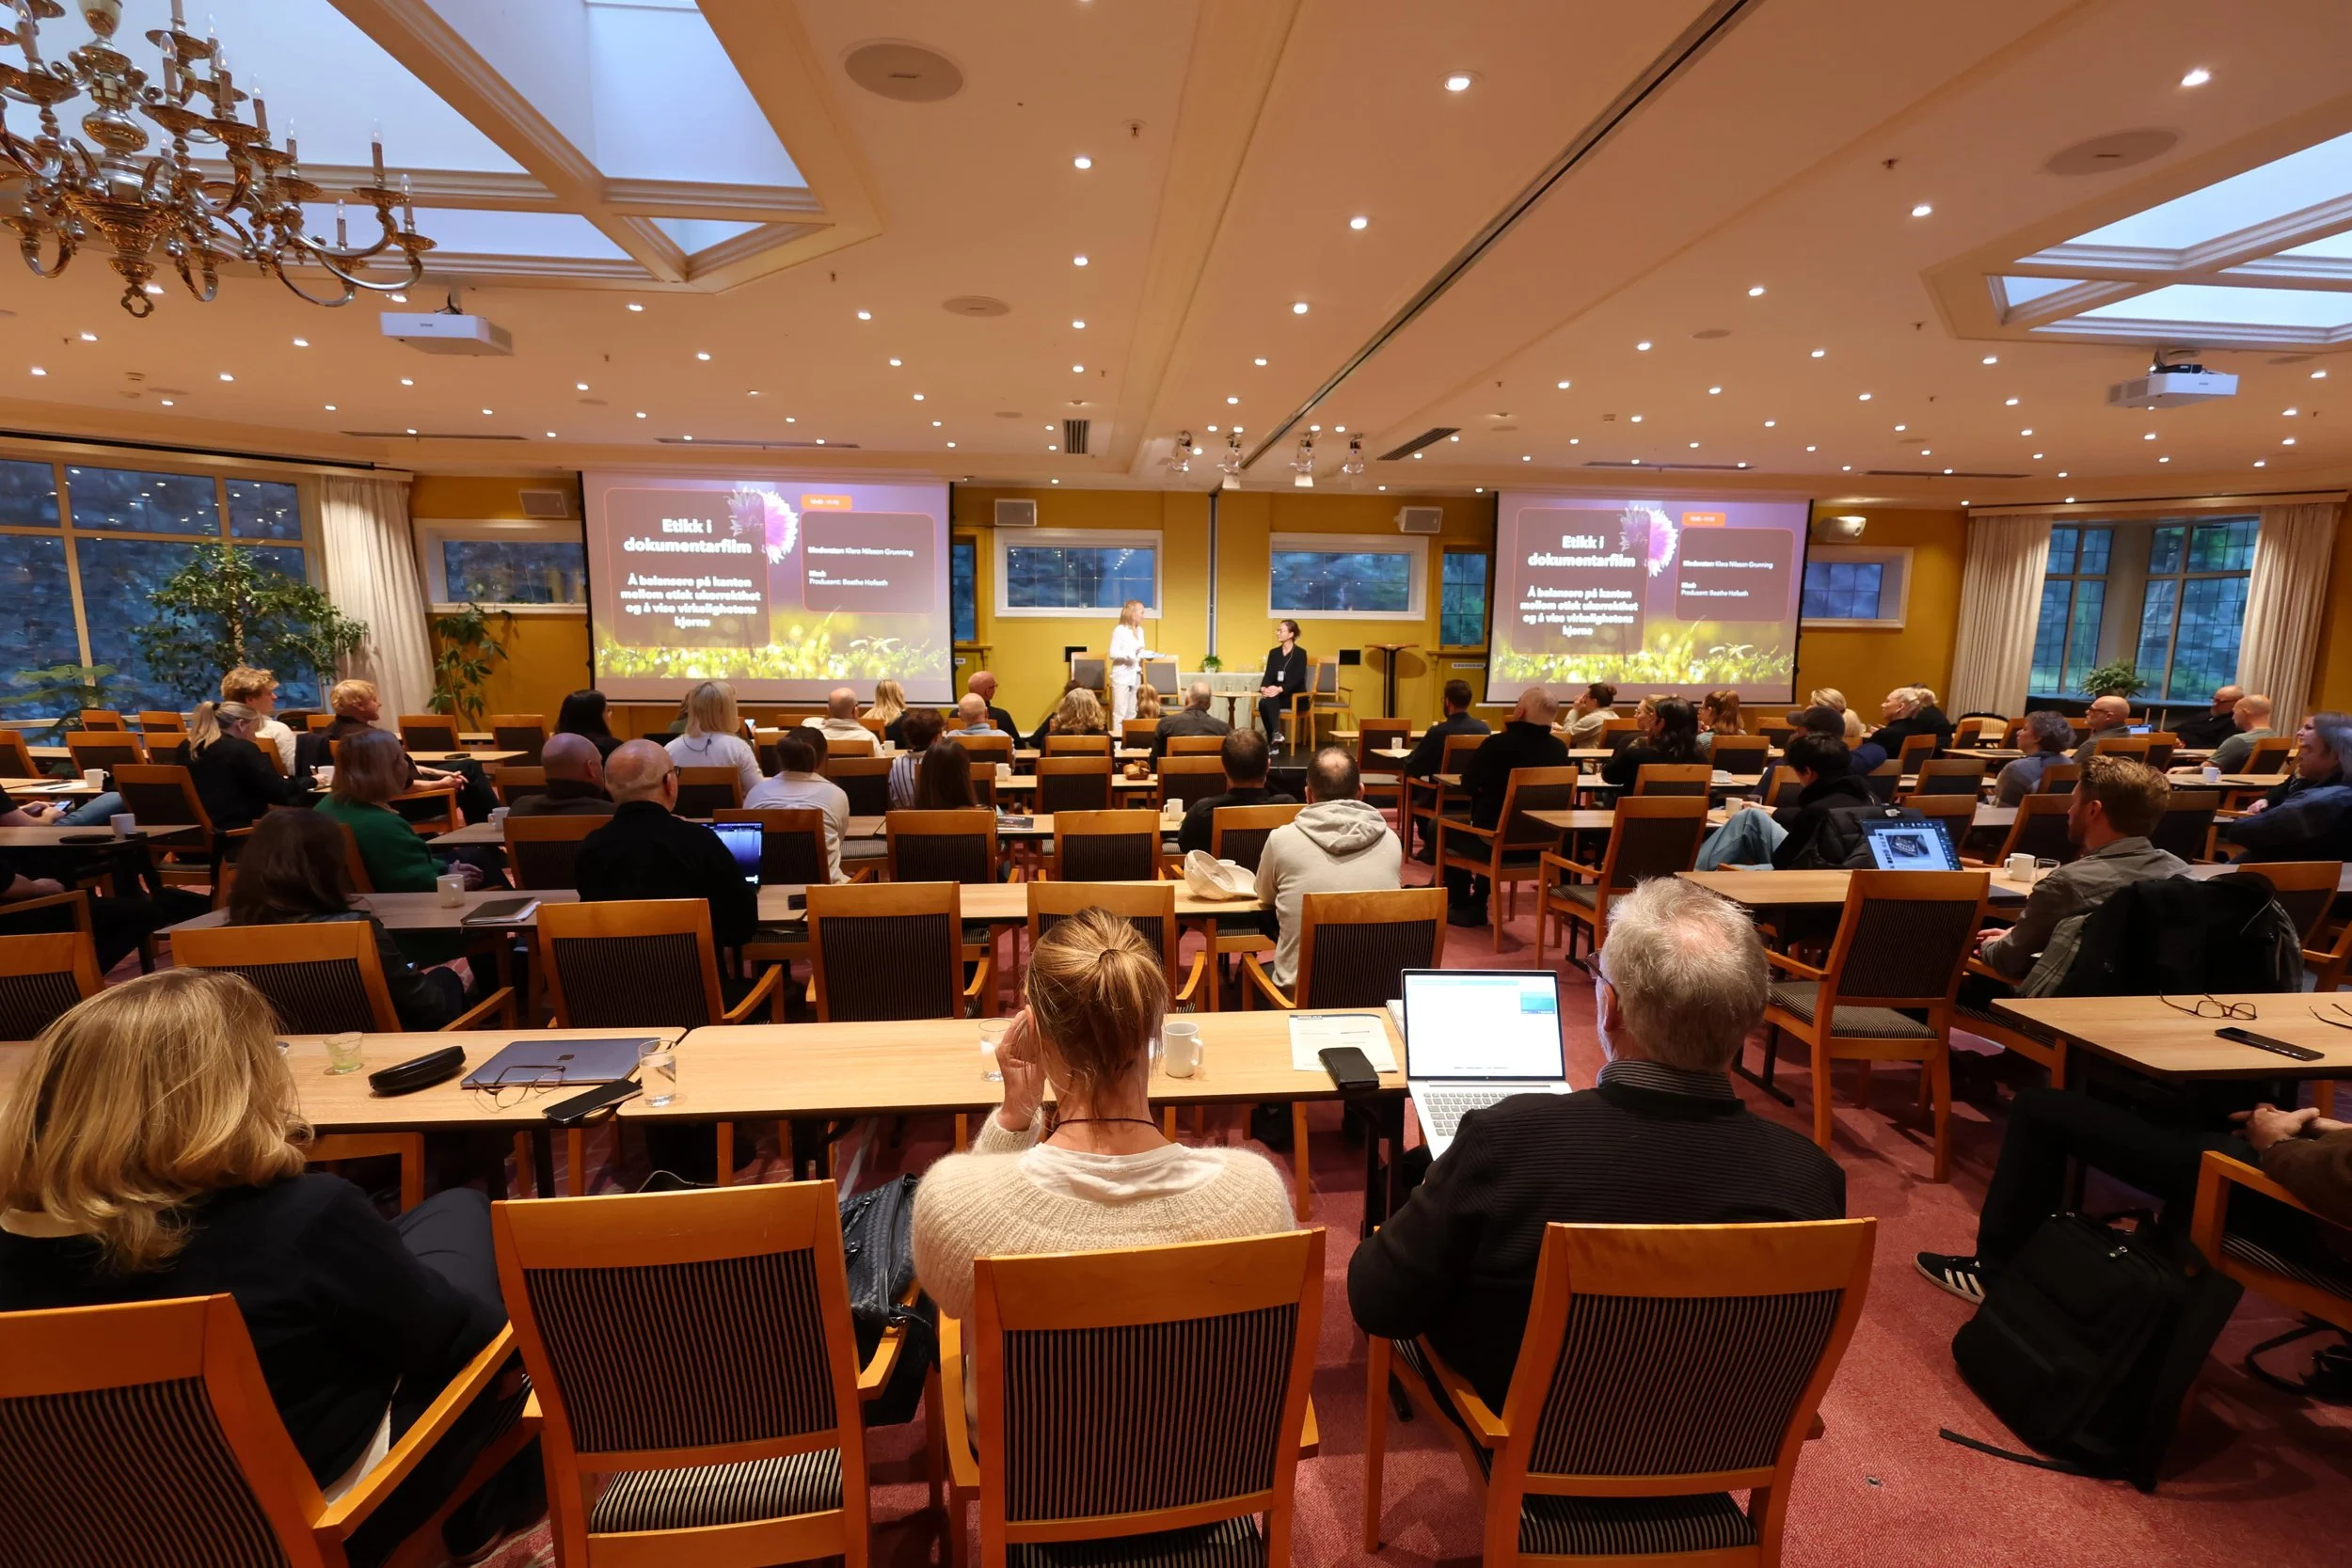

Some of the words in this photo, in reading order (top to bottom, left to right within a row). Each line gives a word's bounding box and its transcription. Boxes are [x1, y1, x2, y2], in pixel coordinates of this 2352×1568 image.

[662, 519, 704, 533] Etikk
[707, 519, 712, 533] i
[624, 537, 752, 553] dokumentarfilm
[1562, 535, 1597, 549] Etikk
[1598, 535, 1605, 549] i
[1527, 552, 1636, 567] dokumentarfilm
[628, 573, 638, 585] Å
[639, 576, 693, 586] balansere
[696, 577, 711, 588] på
[713, 577, 752, 587] kanten
[621, 589, 663, 599] mellom
[665, 590, 692, 599] etisk
[695, 590, 761, 600] ukorrekthet
[1527, 585, 1535, 597] Å
[1537, 587, 1583, 598] balansere
[1584, 588, 1597, 600] på
[1598, 588, 1632, 598] kanten
[626, 605, 641, 614] og
[644, 603, 650, 612] å
[652, 603, 675, 612] vise
[677, 603, 756, 615] virkelighetens
[1519, 600, 1557, 610] mellom
[1557, 600, 1581, 610] etisk
[675, 616, 710, 628] kjerne
[1522, 613, 1536, 625] og
[1537, 612, 1545, 623] å
[1545, 613, 1565, 623] vise
[1562, 625, 1594, 638] kjerne
